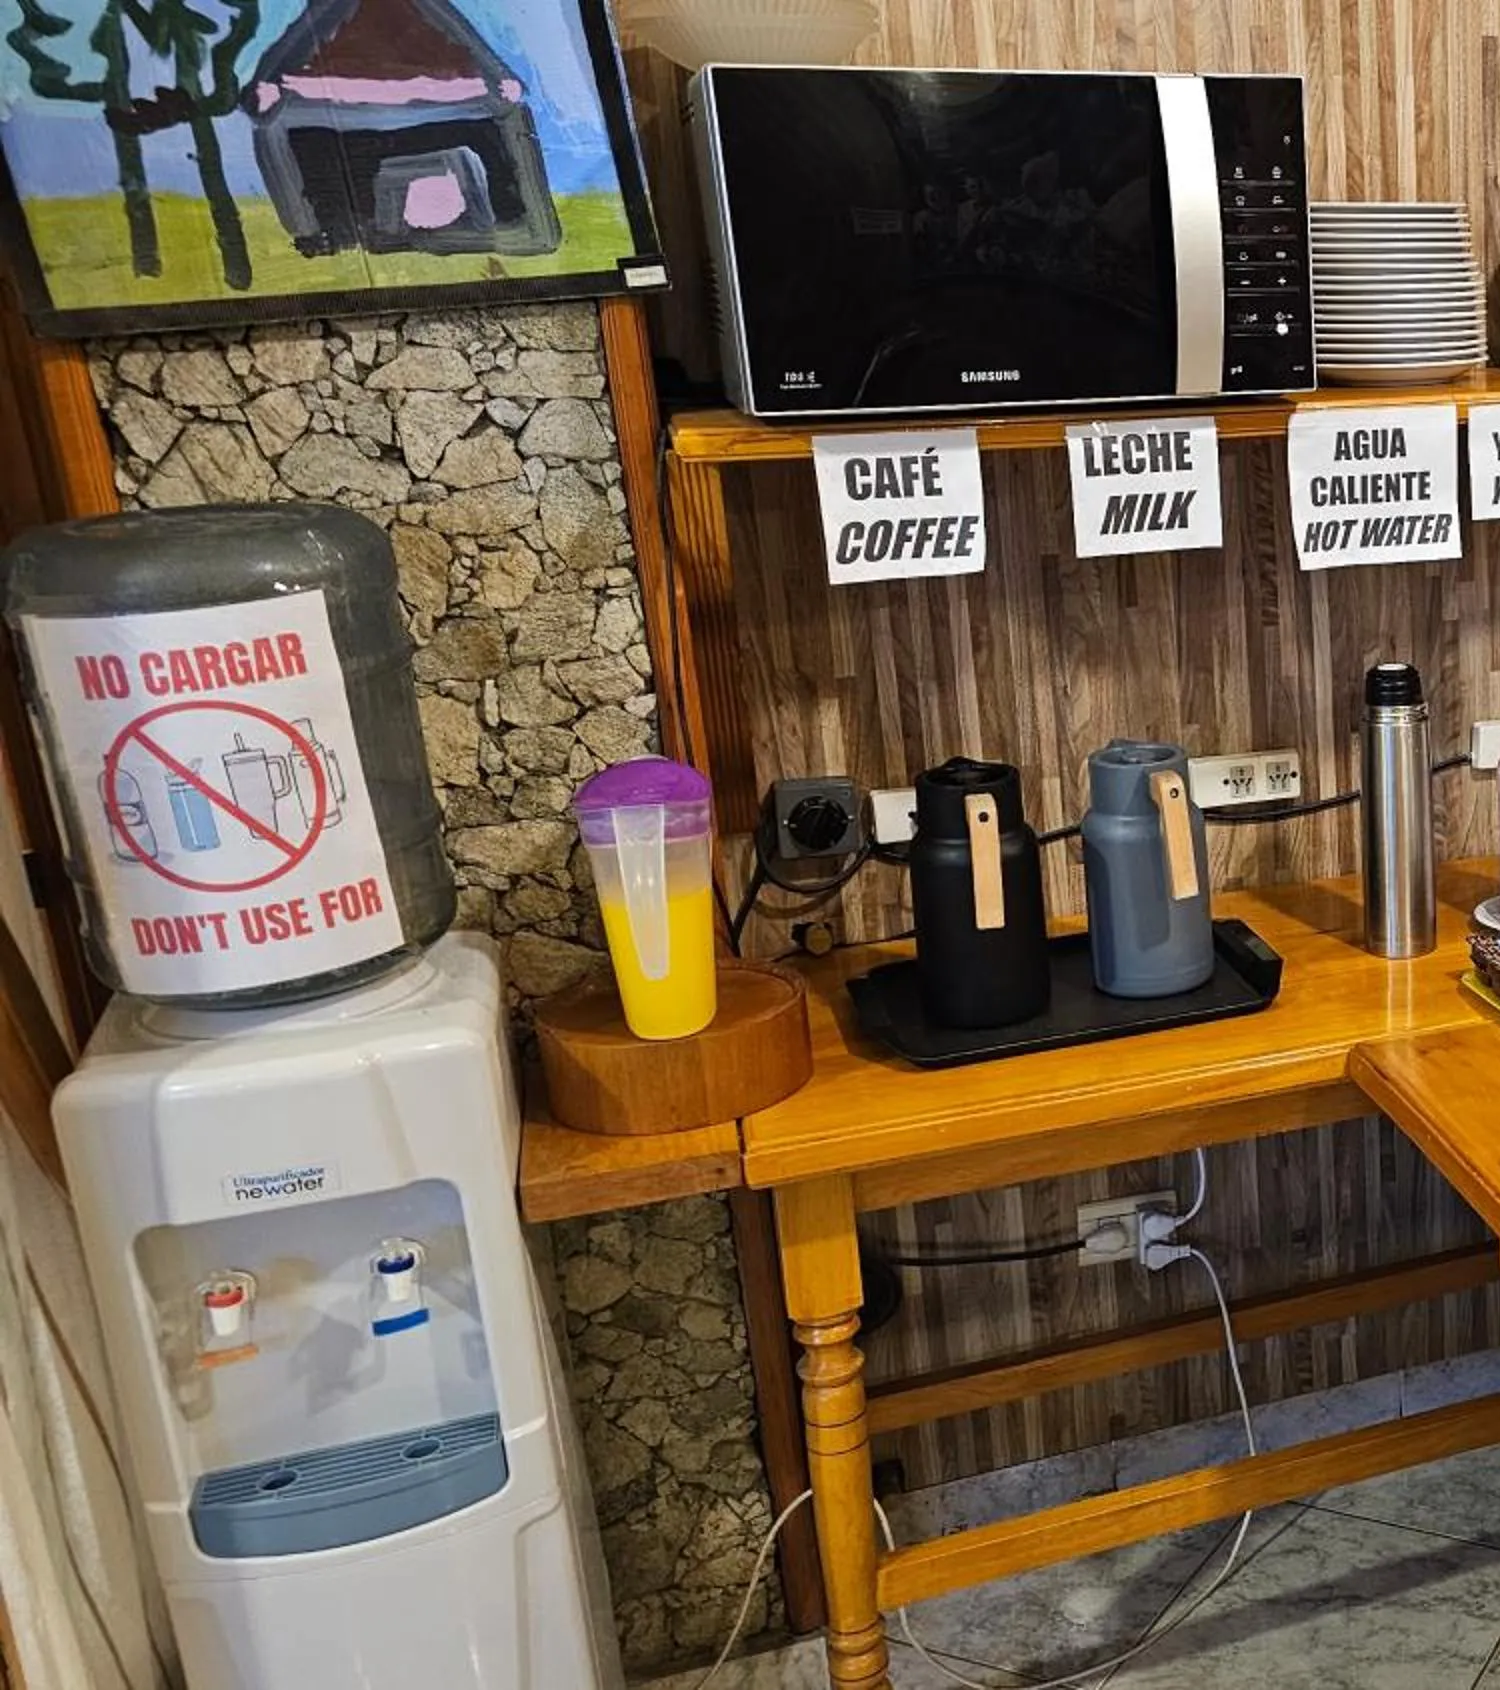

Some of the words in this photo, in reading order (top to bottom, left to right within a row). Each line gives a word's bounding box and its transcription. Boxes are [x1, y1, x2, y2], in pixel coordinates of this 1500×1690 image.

[960, 370, 1021, 383] SAMSUNG
[1083, 431, 1193, 477] LECHE
[1334, 427, 1407, 461] AGUA
[843, 447, 943, 501] CAFÉ
[1310, 471, 1431, 507] CALIENTE
[1100, 490, 1197, 534] MILK
[1303, 519, 1359, 553] HOT
[1360, 513, 1453, 548] WATER
[835, 516, 980, 564] COFFEE
[75, 655, 131, 701] NO
[139, 632, 307, 697] CARGAR
[130, 912, 229, 956] DON'T
[239, 899, 313, 945] USE
[322, 877, 383, 930] FOR
[235, 1177, 325, 1200] newater
